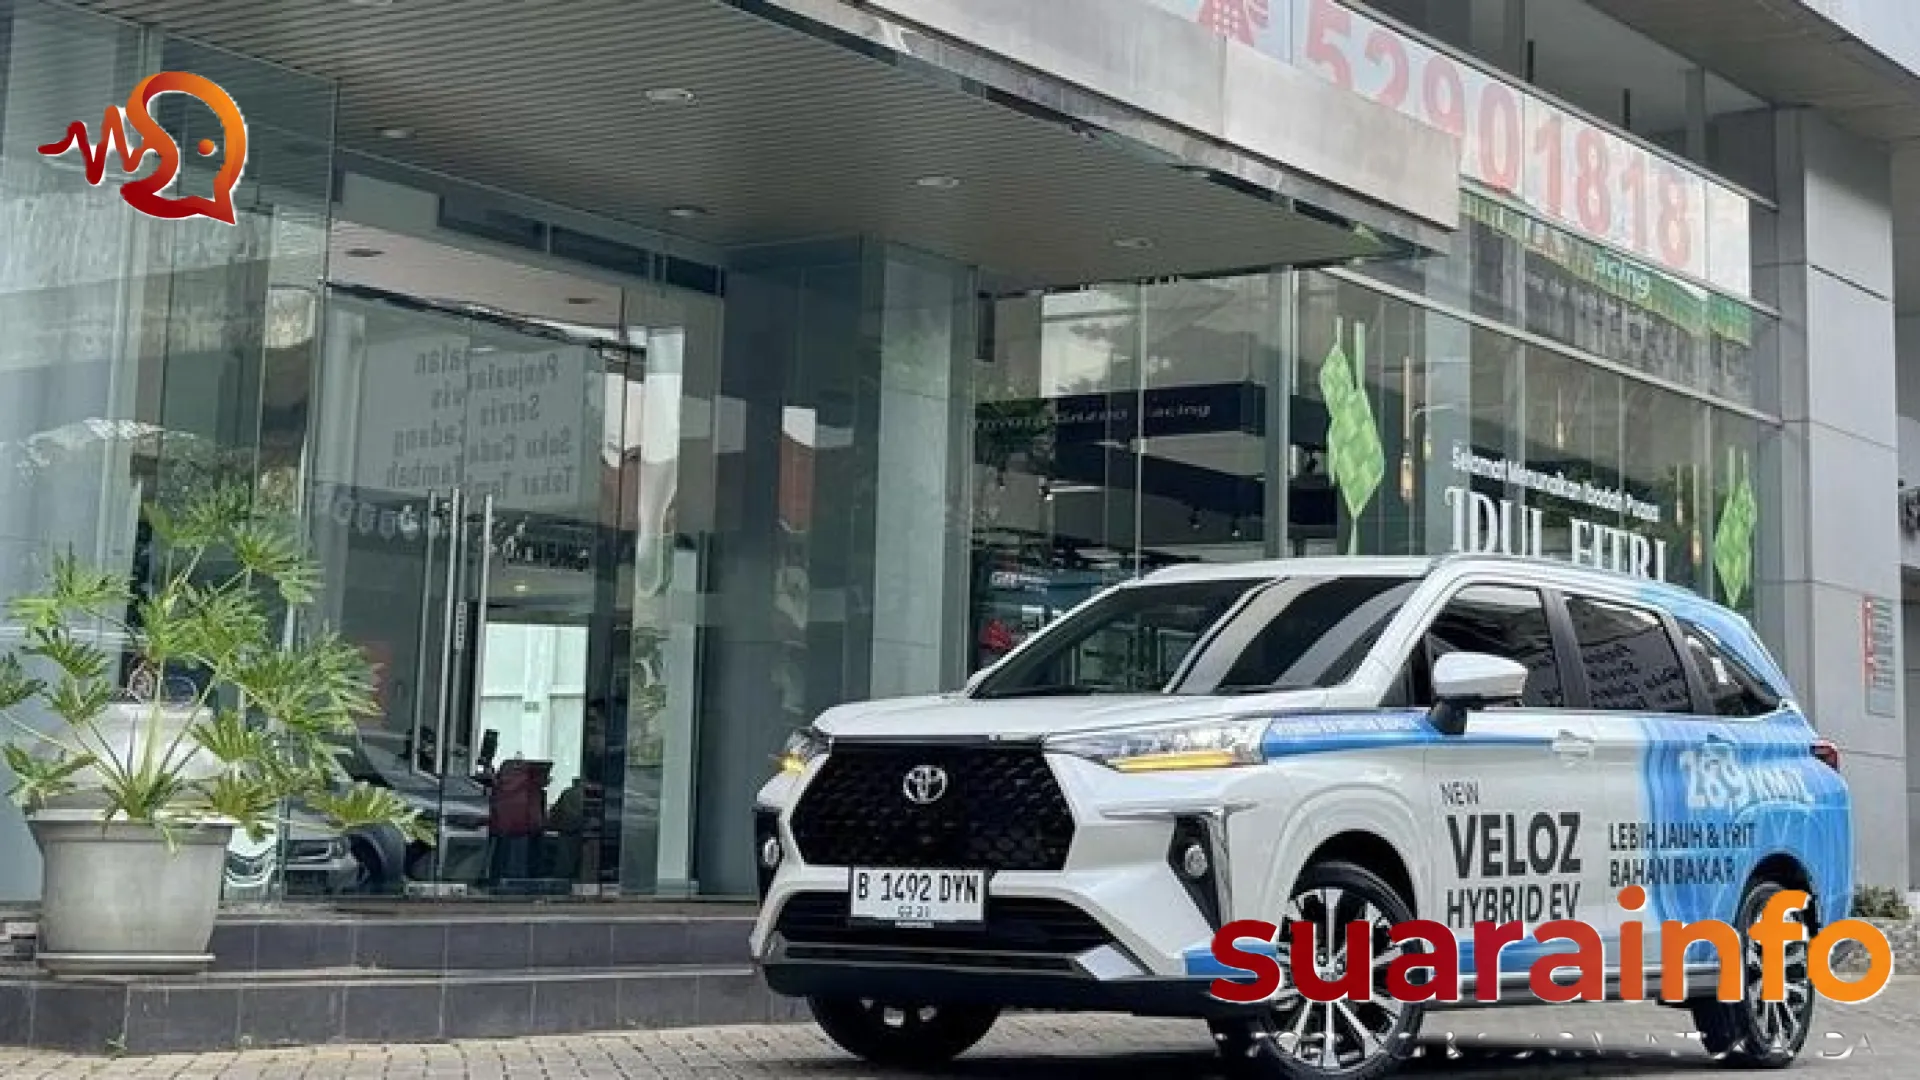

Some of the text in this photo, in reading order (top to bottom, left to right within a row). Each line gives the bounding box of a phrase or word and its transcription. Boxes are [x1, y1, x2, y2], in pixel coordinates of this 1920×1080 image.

[1440, 781, 1479, 805] NEW
[1446, 811, 1581, 879] VELOZ
[1608, 822, 1656, 851] LEBIH
[1659, 821, 1702, 849] JAUH
[1706, 821, 1720, 849] &
[858, 872, 979, 904] B 1492 DYN
[1608, 857, 1735, 888] BAHAN BAKAR
[1446, 881, 1581, 928] HYBRID EV
